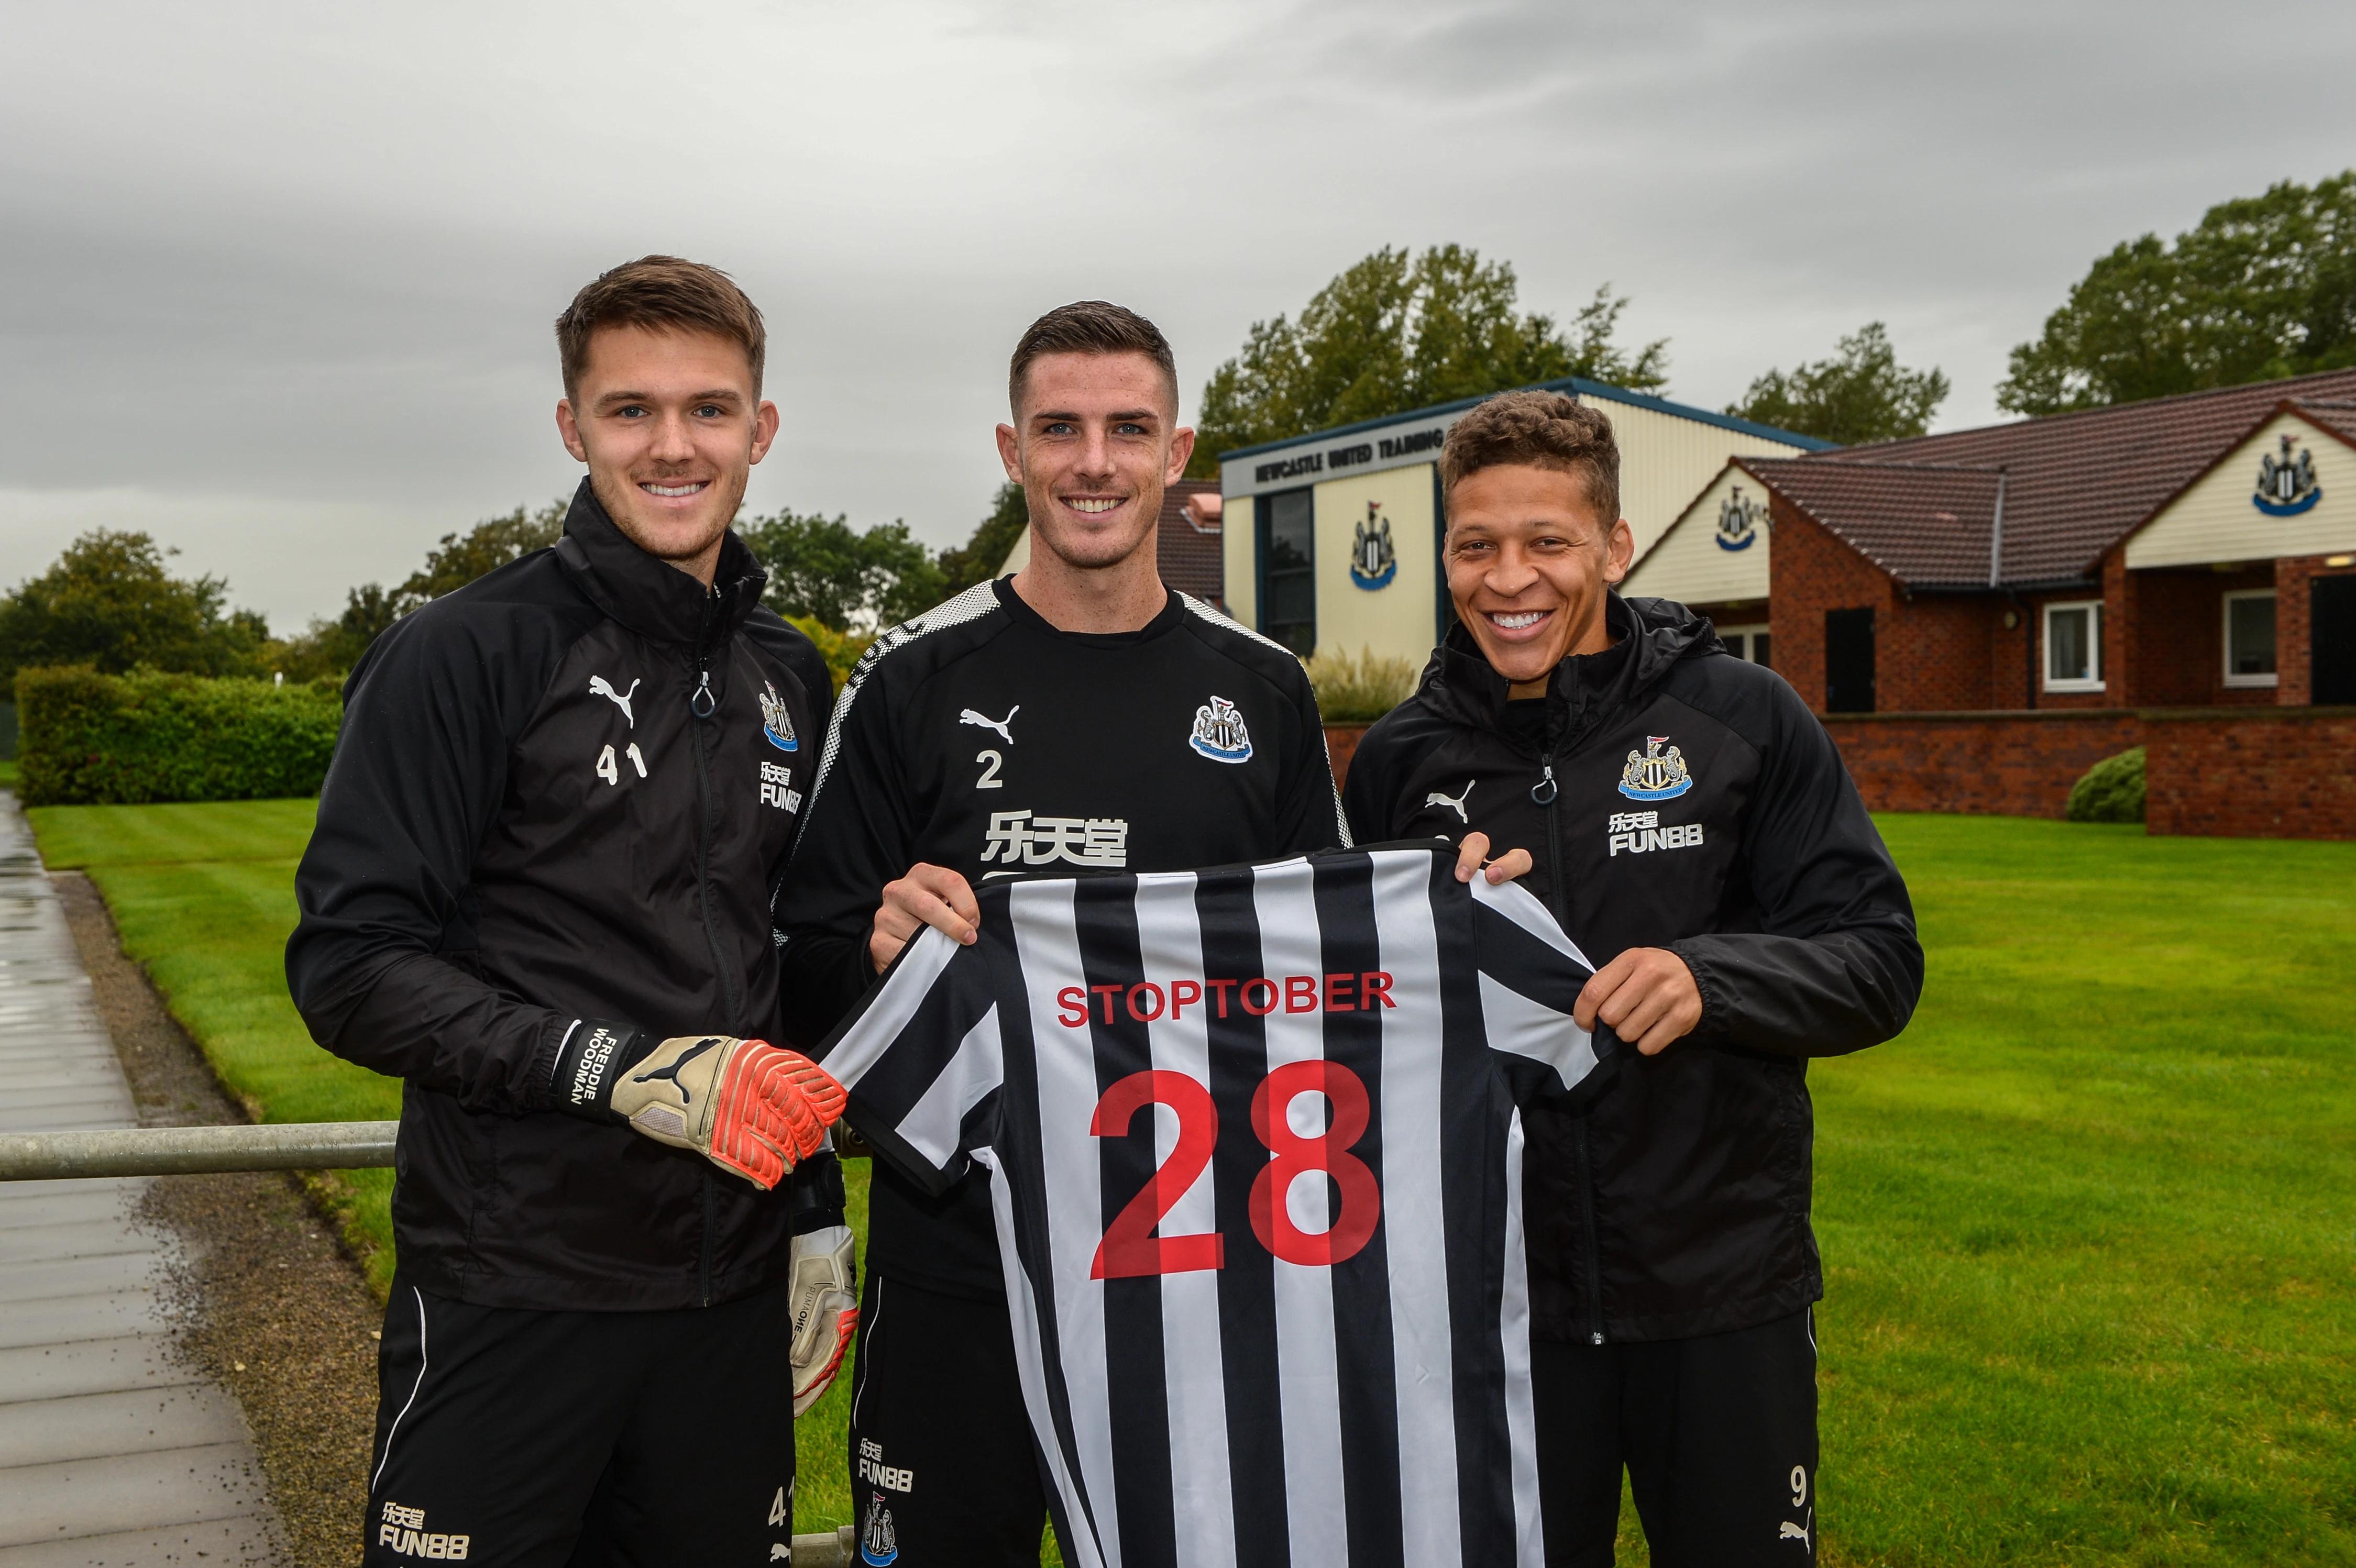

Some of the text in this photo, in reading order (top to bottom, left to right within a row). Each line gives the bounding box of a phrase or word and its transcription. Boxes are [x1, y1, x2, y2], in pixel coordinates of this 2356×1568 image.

[1255, 428, 1444, 482] NEWCASTLE UNITED TRAINING
[596, 743, 647, 785] 41
[976, 749, 1003, 789] 2
[1203, 746, 1229, 757] NEWCASTLE
[760, 761, 791, 786] 乐天堂
[761, 782, 802, 815] FUN88
[1662, 788, 1682, 797] UNITED
[980, 809, 1128, 867] 乐天堂
[1608, 811, 1658, 833] 乐天堂
[1610, 823, 1703, 857] FUN88
[1056, 971, 1397, 1028] STOPTOBER
[571, 1028, 609, 1105] WOODMAN
[584, 1036, 618, 1100] FREDDIE
[1089, 1059, 1380, 1280] 28
[859, 1437, 882, 1462] 乐天堂
[859, 1457, 913, 1493] FUN88
[1790, 1465, 1807, 1507] 9
[381, 1501, 425, 1530] 乐天堂
[379, 1523, 470, 1560] FUN88
